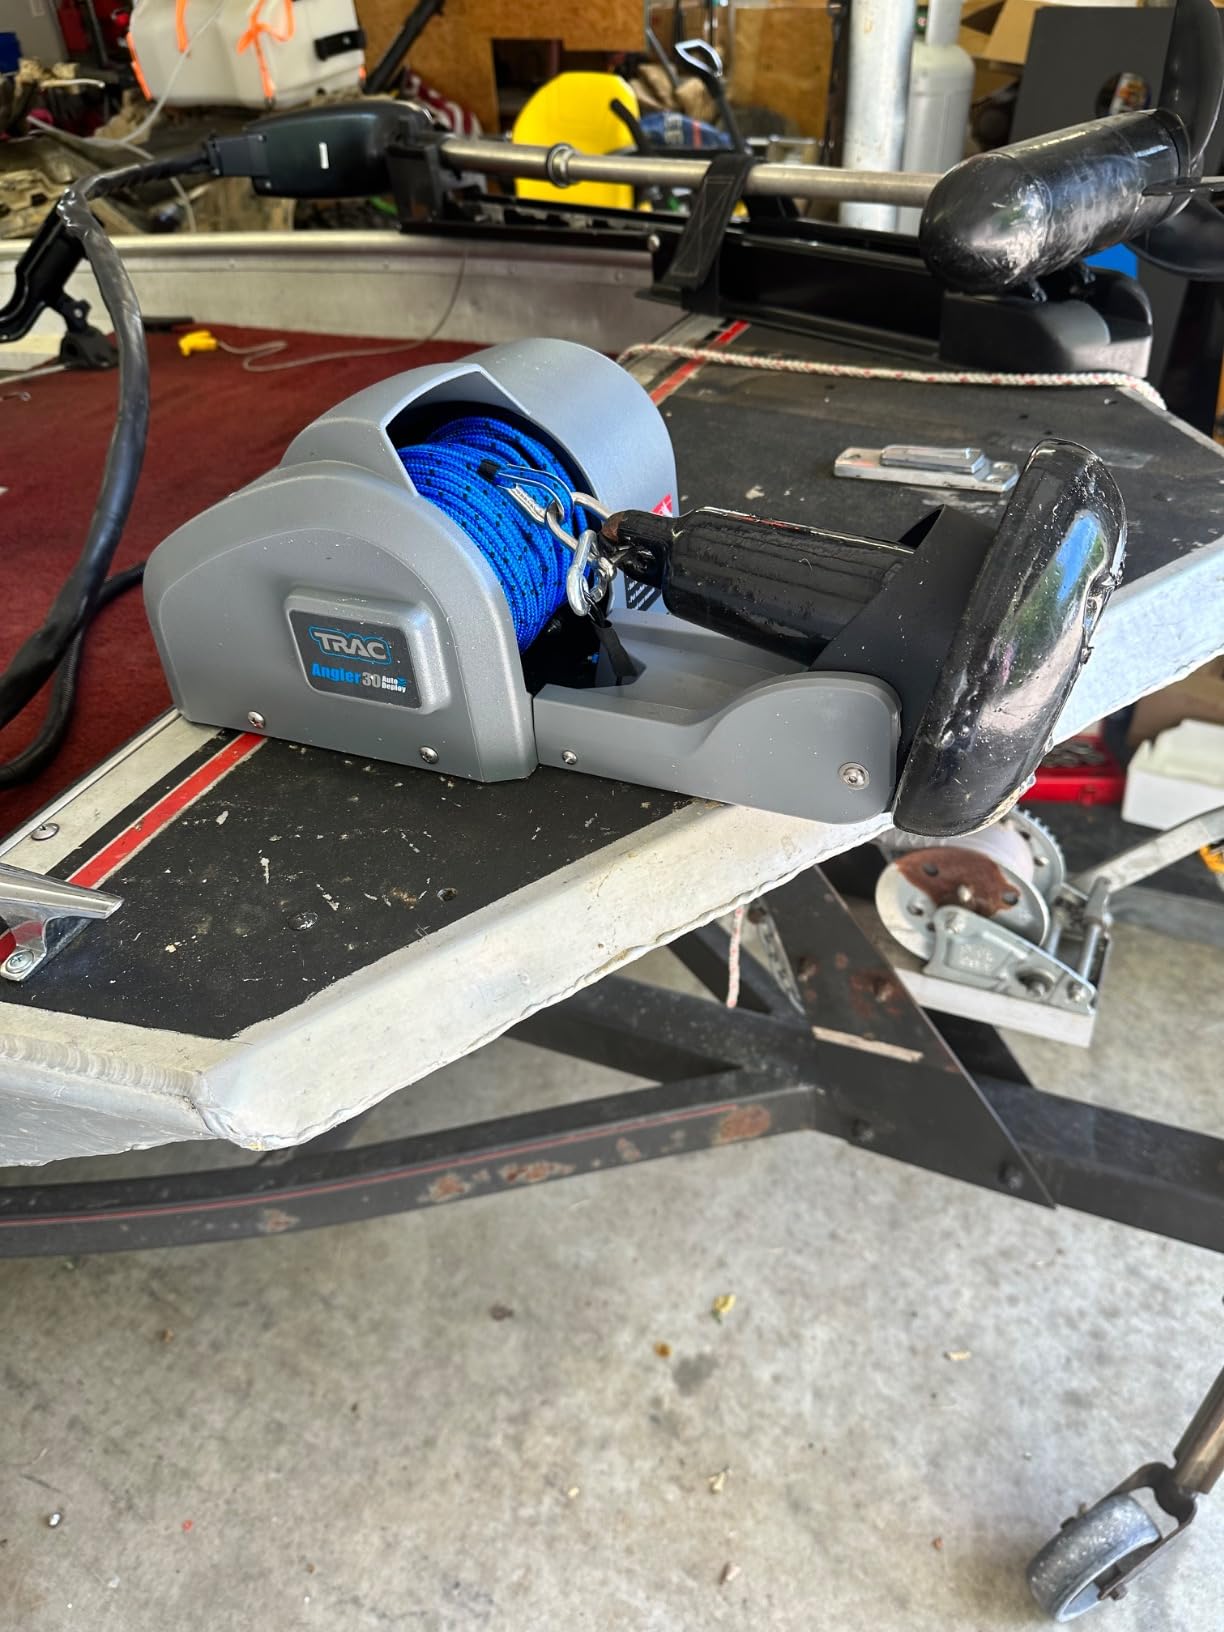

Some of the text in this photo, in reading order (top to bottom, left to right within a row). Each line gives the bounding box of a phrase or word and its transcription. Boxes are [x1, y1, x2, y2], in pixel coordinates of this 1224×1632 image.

[314, 632, 387, 660] TRAC
[382, 675, 398, 685] Auto
[382, 683, 406, 693] Deploy
